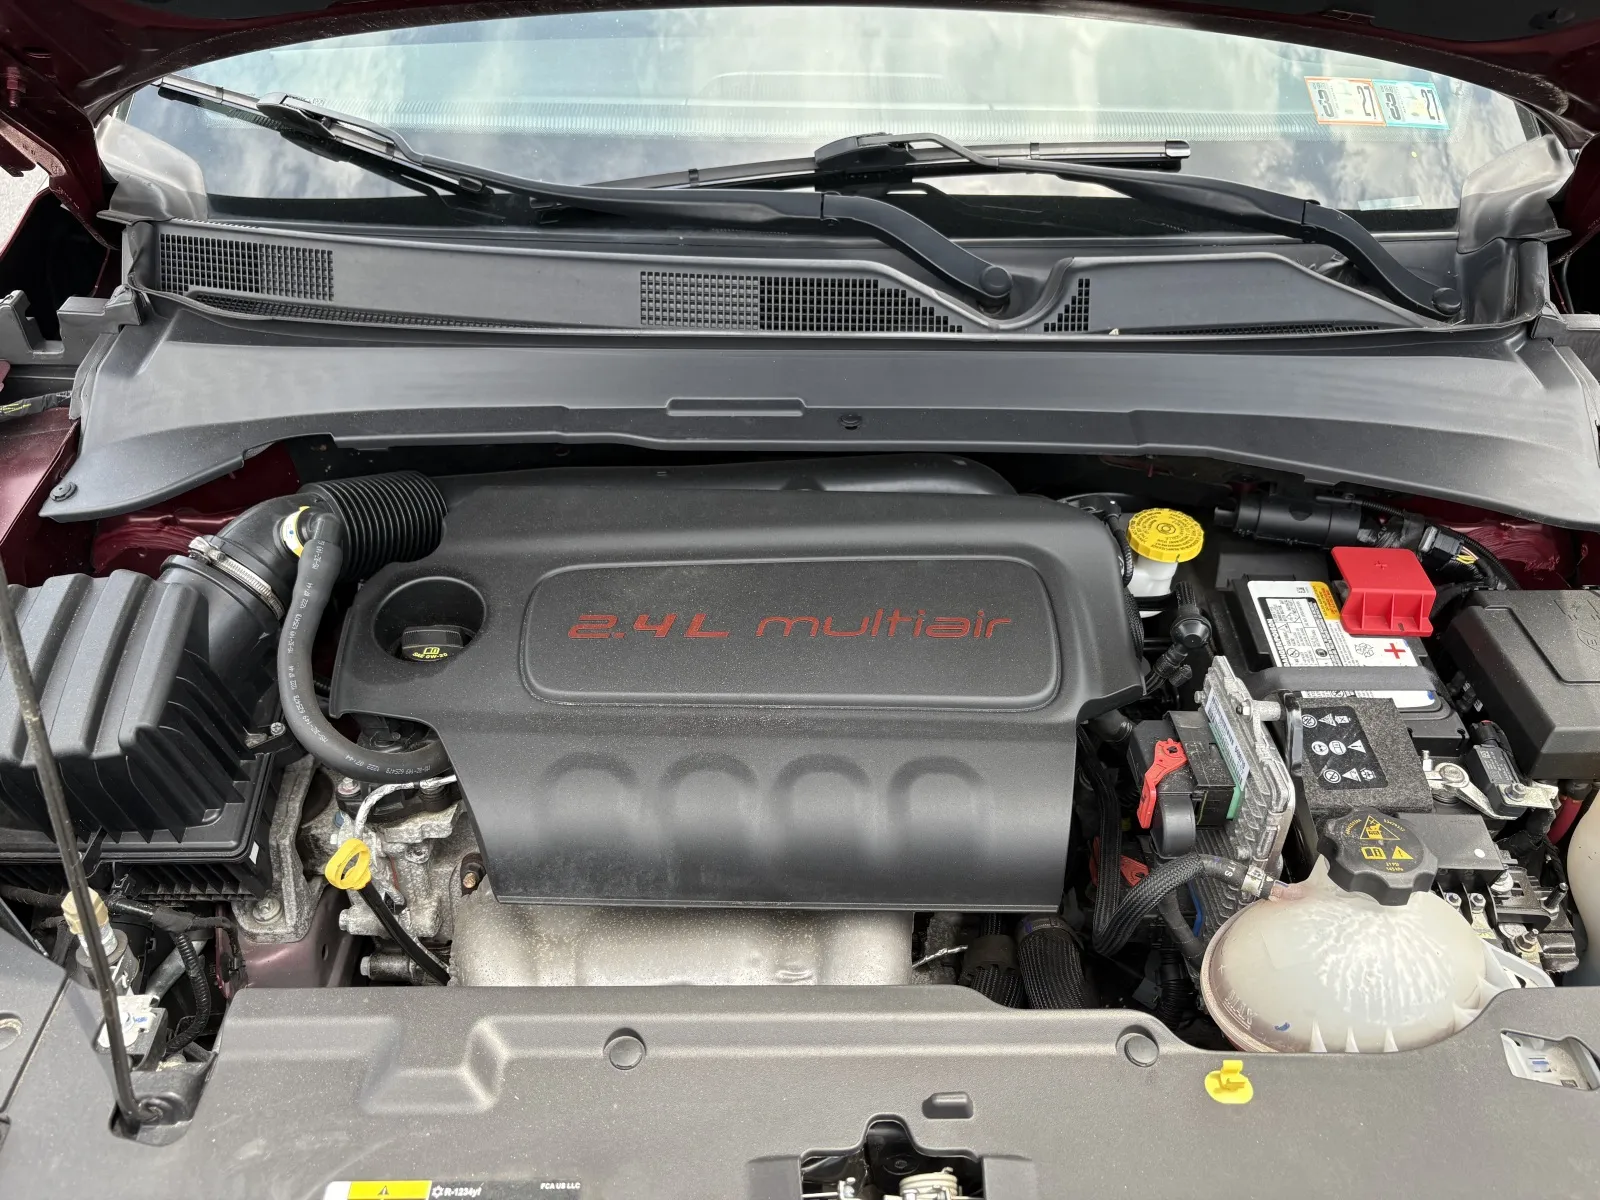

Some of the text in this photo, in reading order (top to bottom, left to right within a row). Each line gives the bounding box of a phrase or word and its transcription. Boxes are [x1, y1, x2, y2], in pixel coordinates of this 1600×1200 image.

[1317, 89, 1335, 118] 3
[1357, 85, 1377, 119] 27
[1385, 92, 1402, 121] 3
[1420, 88, 1441, 121] 27
[755, 608, 1012, 639] multiair
[366, 763, 380, 772] 1222
[444, 1187, 482, 1199] R-1234yf
[540, 1182, 581, 1190] FCA US LLC
